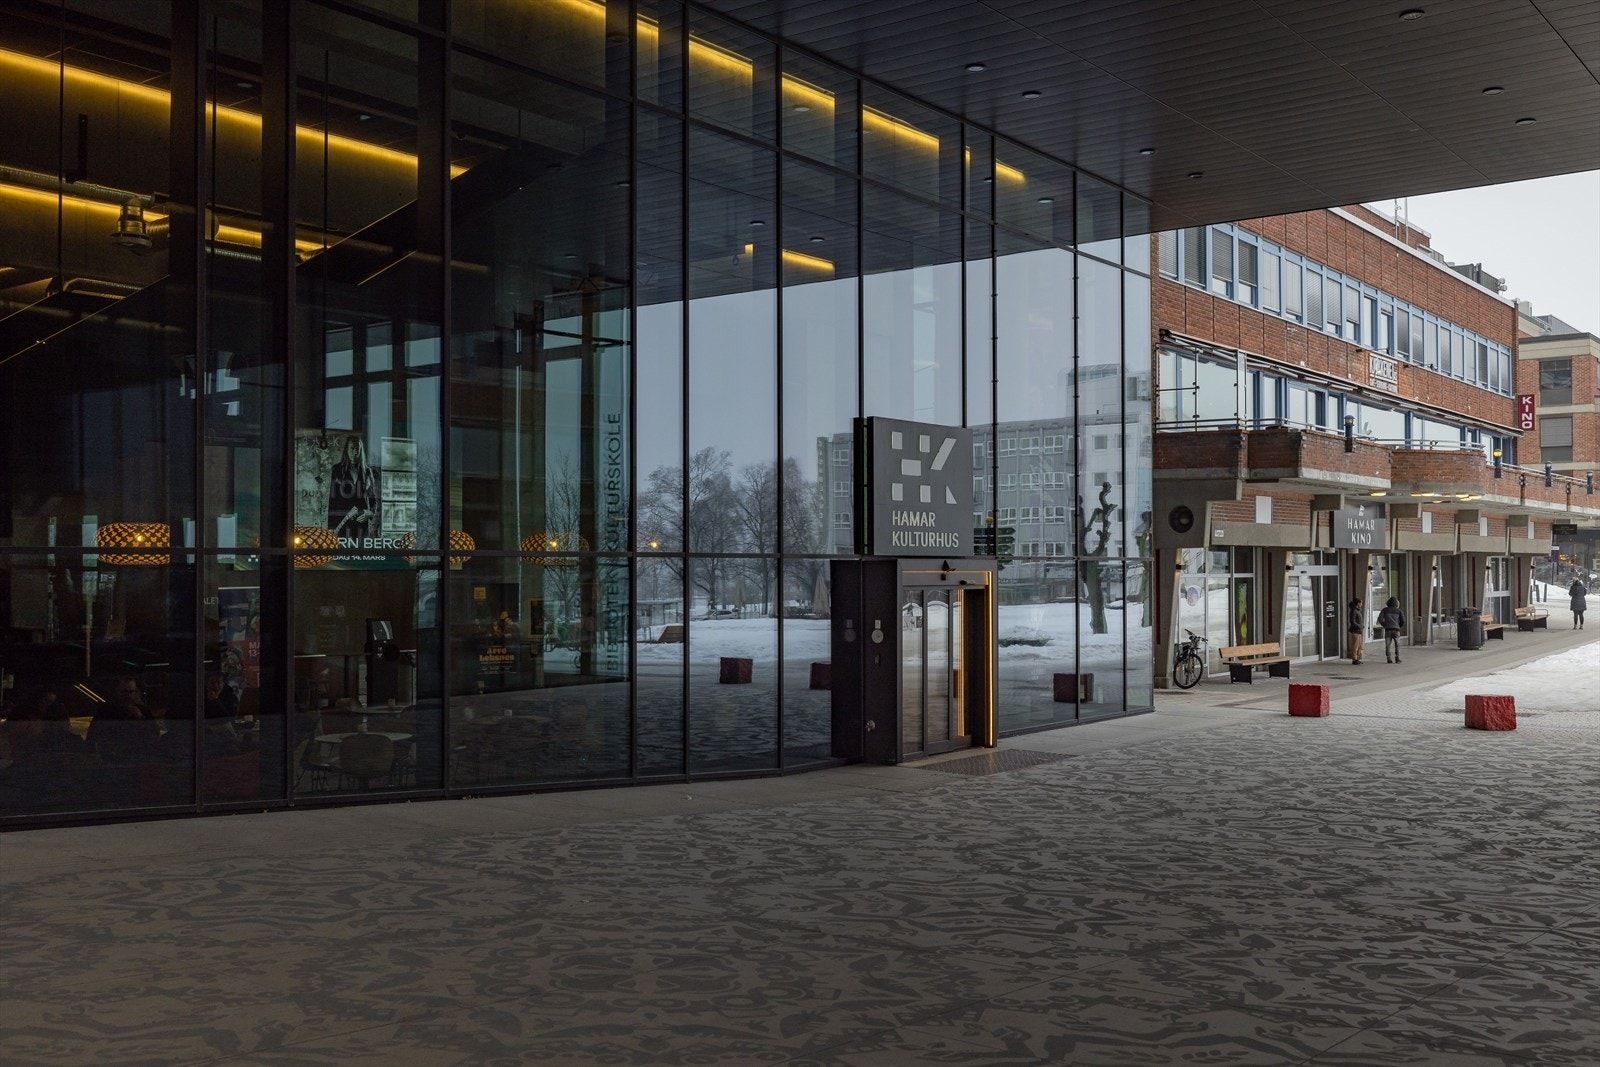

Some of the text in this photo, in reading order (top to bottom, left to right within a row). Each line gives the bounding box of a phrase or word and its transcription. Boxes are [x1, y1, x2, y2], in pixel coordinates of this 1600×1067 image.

[1521, 396, 1533, 429] KINO
[892, 510, 936, 528] HAMAR
[1347, 517, 1375, 531] HAMAR
[337, 537, 359, 549] RN
[892, 531, 960, 548] KULTURHUS
[1351, 532, 1372, 545] KINO
